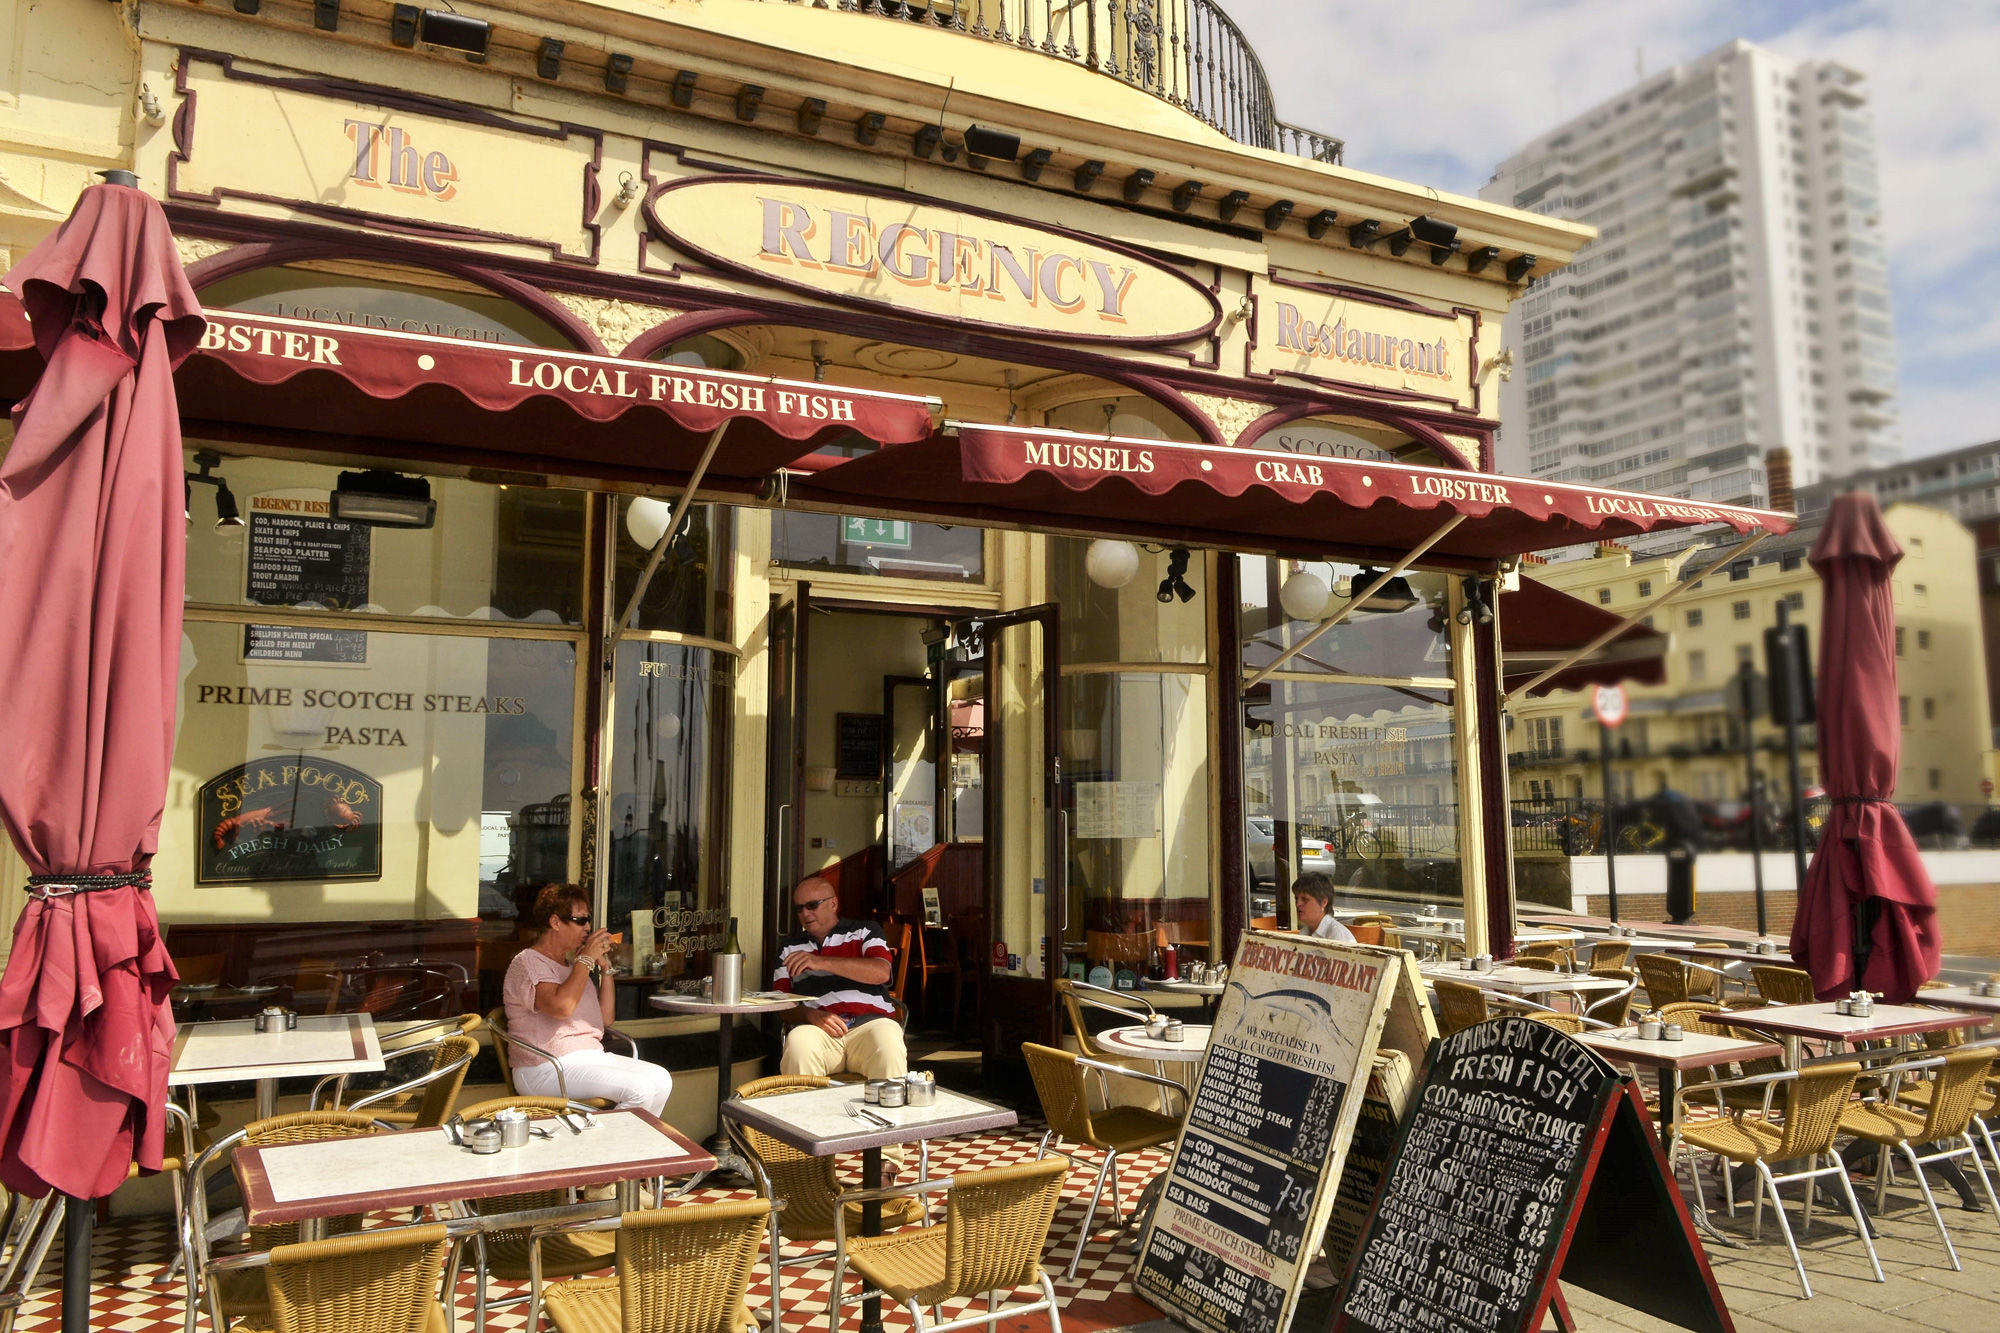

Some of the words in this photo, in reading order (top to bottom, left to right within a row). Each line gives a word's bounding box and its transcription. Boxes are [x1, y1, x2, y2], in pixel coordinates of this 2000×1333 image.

[343, 117, 460, 201] The
[757, 196, 1138, 324] REGENCY
[197, 322, 342, 366] BSTER
[1276, 300, 1452, 382] Restaurant
[508, 358, 638, 398] LOCAL
[649, 374, 767, 412] FRESH
[776, 390, 856, 421] FISH
[1024, 440, 1155, 473] MUSSELS
[1254, 460, 1324, 487] CRAB
[1409, 475, 1512, 505] LOBSTER
[253, 497, 301, 511] REGENCY
[304, 500, 330, 513] REST
[1585, 495, 1654, 517] LOCAL
[1653, 502, 1717, 519] FRESH
[254, 527, 273, 535] SKATE
[333, 523, 350, 531] CHIPS
[253, 546, 293, 555] SEAFOOD
[295, 548, 330, 558] PLATTER
[252, 572, 272, 580] TROUT
[253, 563, 281, 571] SEAFOOD
[283, 564, 302, 573] PASTA
[252, 582, 277, 590] GRILLED
[250, 630, 281, 639] SHELLFISH
[283, 632, 308, 640] PLATTER
[309, 633, 333, 641] SPECIAL
[250, 640, 275, 648] GRILLED
[292, 641, 315, 649] MEDLEY
[197, 685, 292, 706] PRIME
[303, 690, 414, 712] SCOTCH
[423, 694, 526, 715] STEAKS
[325, 726, 408, 747] PASTA
[1262, 723, 1314, 739] LOCAL
[1319, 725, 1368, 740] FRESH
[1374, 727, 1407, 742] FISH
[1314, 751, 1359, 766] PASTA
[216, 765, 371, 817] SEAFOOD
[228, 836, 289, 861] FRESH
[297, 834, 345, 855] DAILY
[1223, 1034, 1249, 1051] LOCAL
[1250, 1041, 1287, 1060] CAUGHT
[1286, 1051, 1317, 1071] FRESH
[1260, 1029, 1309, 1052] SPECIALISE
[1310, 1044, 1322, 1055] IN
[1436, 1020, 1500, 1063] FAMOUS
[1502, 1019, 1539, 1052] FOR
[1540, 1032, 1595, 1092] LOCAL
[1210, 1056, 1237, 1071] LEMON
[1238, 1065, 1259, 1079] SOLE
[1213, 1046, 1239, 1060] DOVER
[1240, 1053, 1260, 1067] SOLE
[1203, 1077, 1235, 1095] HALIBUT
[1236, 1088, 1262, 1105] STEAK
[1236, 1076, 1263, 1093] PLAICE
[1450, 1054, 1514, 1083] FRESH
[1516, 1059, 1579, 1110] FISH
[1193, 1107, 1214, 1122] KING
[1214, 1116, 1250, 1137] PRAWNS
[1197, 1097, 1236, 1118] RAINBOW
[1236, 1111, 1263, 1130] TROUT
[1200, 1087, 1230, 1105] SCOTCH
[1230, 1097, 1265, 1118] SALMON
[1266, 1111, 1294, 1129] STEAK
[1195, 1140, 1214, 1156] COD
[1407, 1128, 1452, 1153] ROAST
[1453, 1142, 1490, 1167] LAMB
[1458, 1125, 1497, 1150] BEEF
[1190, 1153, 1221, 1177] PLAICE
[1440, 1158, 1493, 1186] CHICKEN
[1186, 1166, 1231, 1195] HADDOCK
[1431, 1169, 1460, 1196] MADE
[1461, 1180, 1494, 1210] FISH
[1494, 1191, 1520, 1220] PIE
[1168, 1186, 1185, 1203] SEA
[1185, 1193, 1210, 1214] BASS
[1389, 1176, 1444, 1207] SEAFOOD
[1450, 1199, 1509, 1236] PLATTER
[1379, 1208, 1416, 1230] GRILLED
[1418, 1223, 1460, 1250] HADDOCK
[1383, 1196, 1426, 1221] GRILLED
[1429, 1209, 1474, 1238] HALIBUT
[1154, 1231, 1186, 1256] SIRLOIN
[1173, 1207, 1203, 1230] PRIME
[1203, 1222, 1243, 1248] SCOTCH
[1241, 1241, 1277, 1269] STEAKS
[1150, 1243, 1175, 1262] RUMP
[1382, 1223, 1434, 1258] SKATE
[1447, 1248, 1480, 1279] FRESH
[1481, 1263, 1511, 1290] CHIPS
[1223, 1267, 1251, 1290] FILLET
[1369, 1239, 1429, 1275] SEAFOOD
[1434, 1265, 1479, 1295] PASTA
[1142, 1266, 1173, 1290] SPECIAL
[1173, 1282, 1202, 1306] MIXED
[1202, 1299, 1227, 1322] GRILL
[1181, 1275, 1243, 1317] PORTERHOUSE
[1214, 1277, 1247, 1304] T-BONE
[1362, 1252, 1437, 1299] SHELLFISH
[1441, 1286, 1500, 1327] PLATTER
[1357, 1279, 1396, 1308] FRUIT
[1398, 1299, 1416, 1317] DE
[1417, 1308, 1446, 1332] MER
